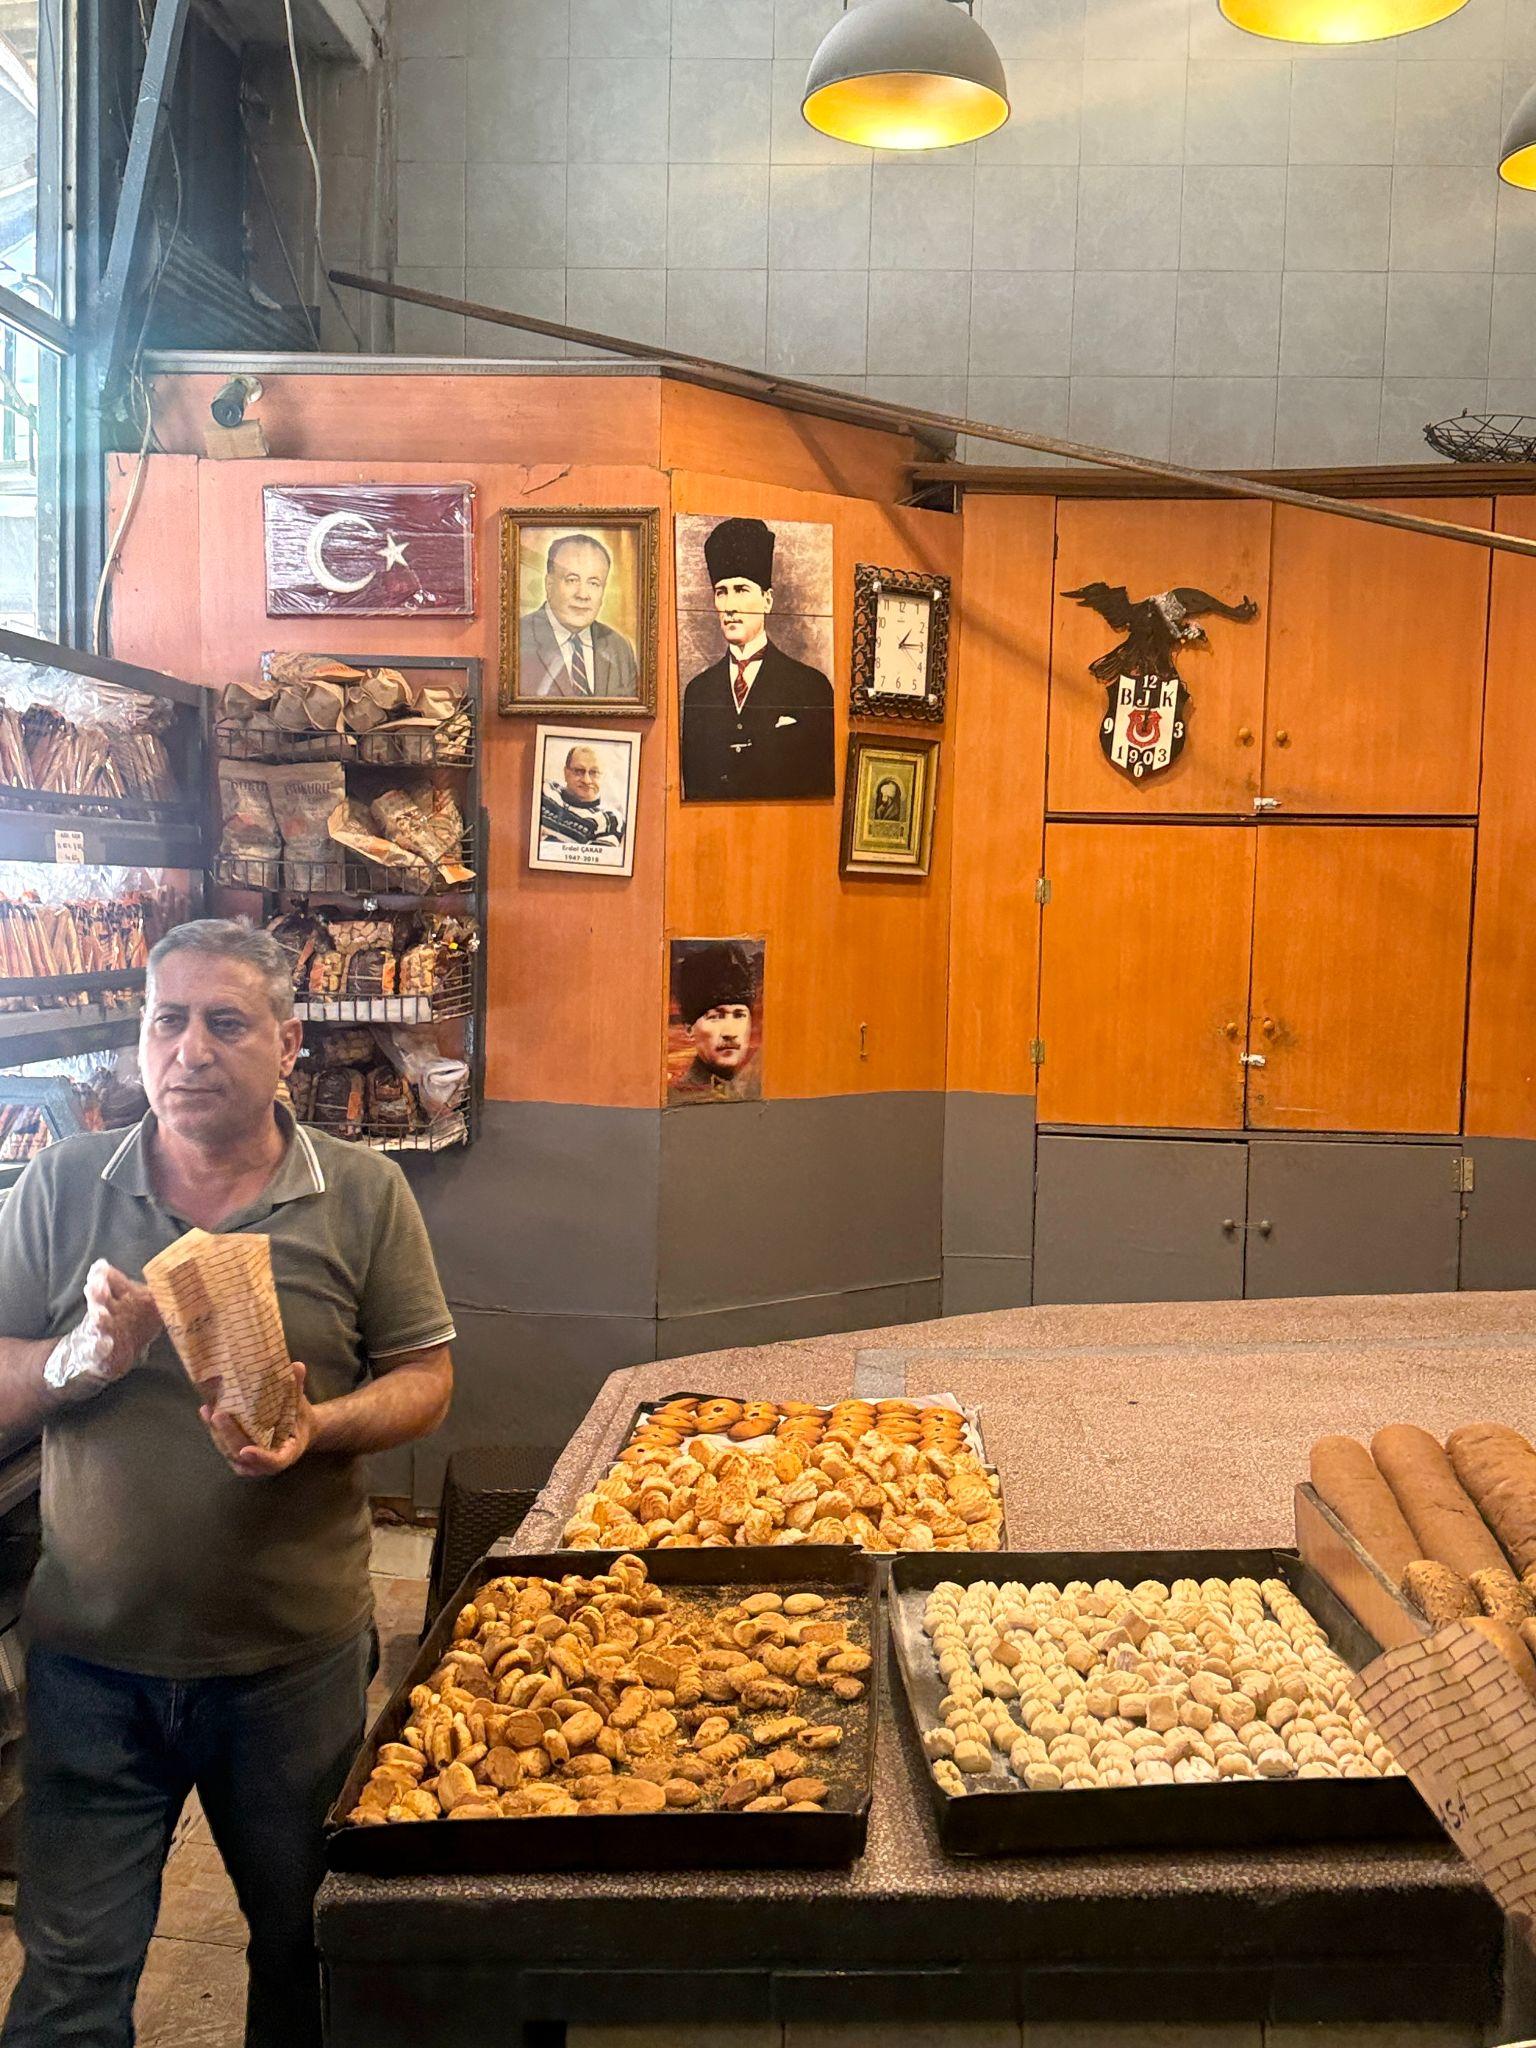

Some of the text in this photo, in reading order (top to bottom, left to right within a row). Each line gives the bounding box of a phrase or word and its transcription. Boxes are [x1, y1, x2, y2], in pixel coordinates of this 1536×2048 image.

[884, 600, 890, 611] 11
[900, 602, 906, 613] 12
[916, 604, 919, 614] 1
[878, 617, 886, 629] 10
[919, 622, 925, 634] 2
[876, 637, 881, 648] 9
[920, 642, 924, 654] 3
[917, 662, 922, 673] 4
[880, 676, 886, 687] 7
[896, 676, 901, 689] 6
[912, 680, 917, 690] 5
[1143, 675, 1158, 688] 12
[1103, 717, 1114, 734] 9
[1173, 721, 1184, 738] 3
[1117, 745, 1167, 765] 1903
[1133, 761, 1144, 777] 6
